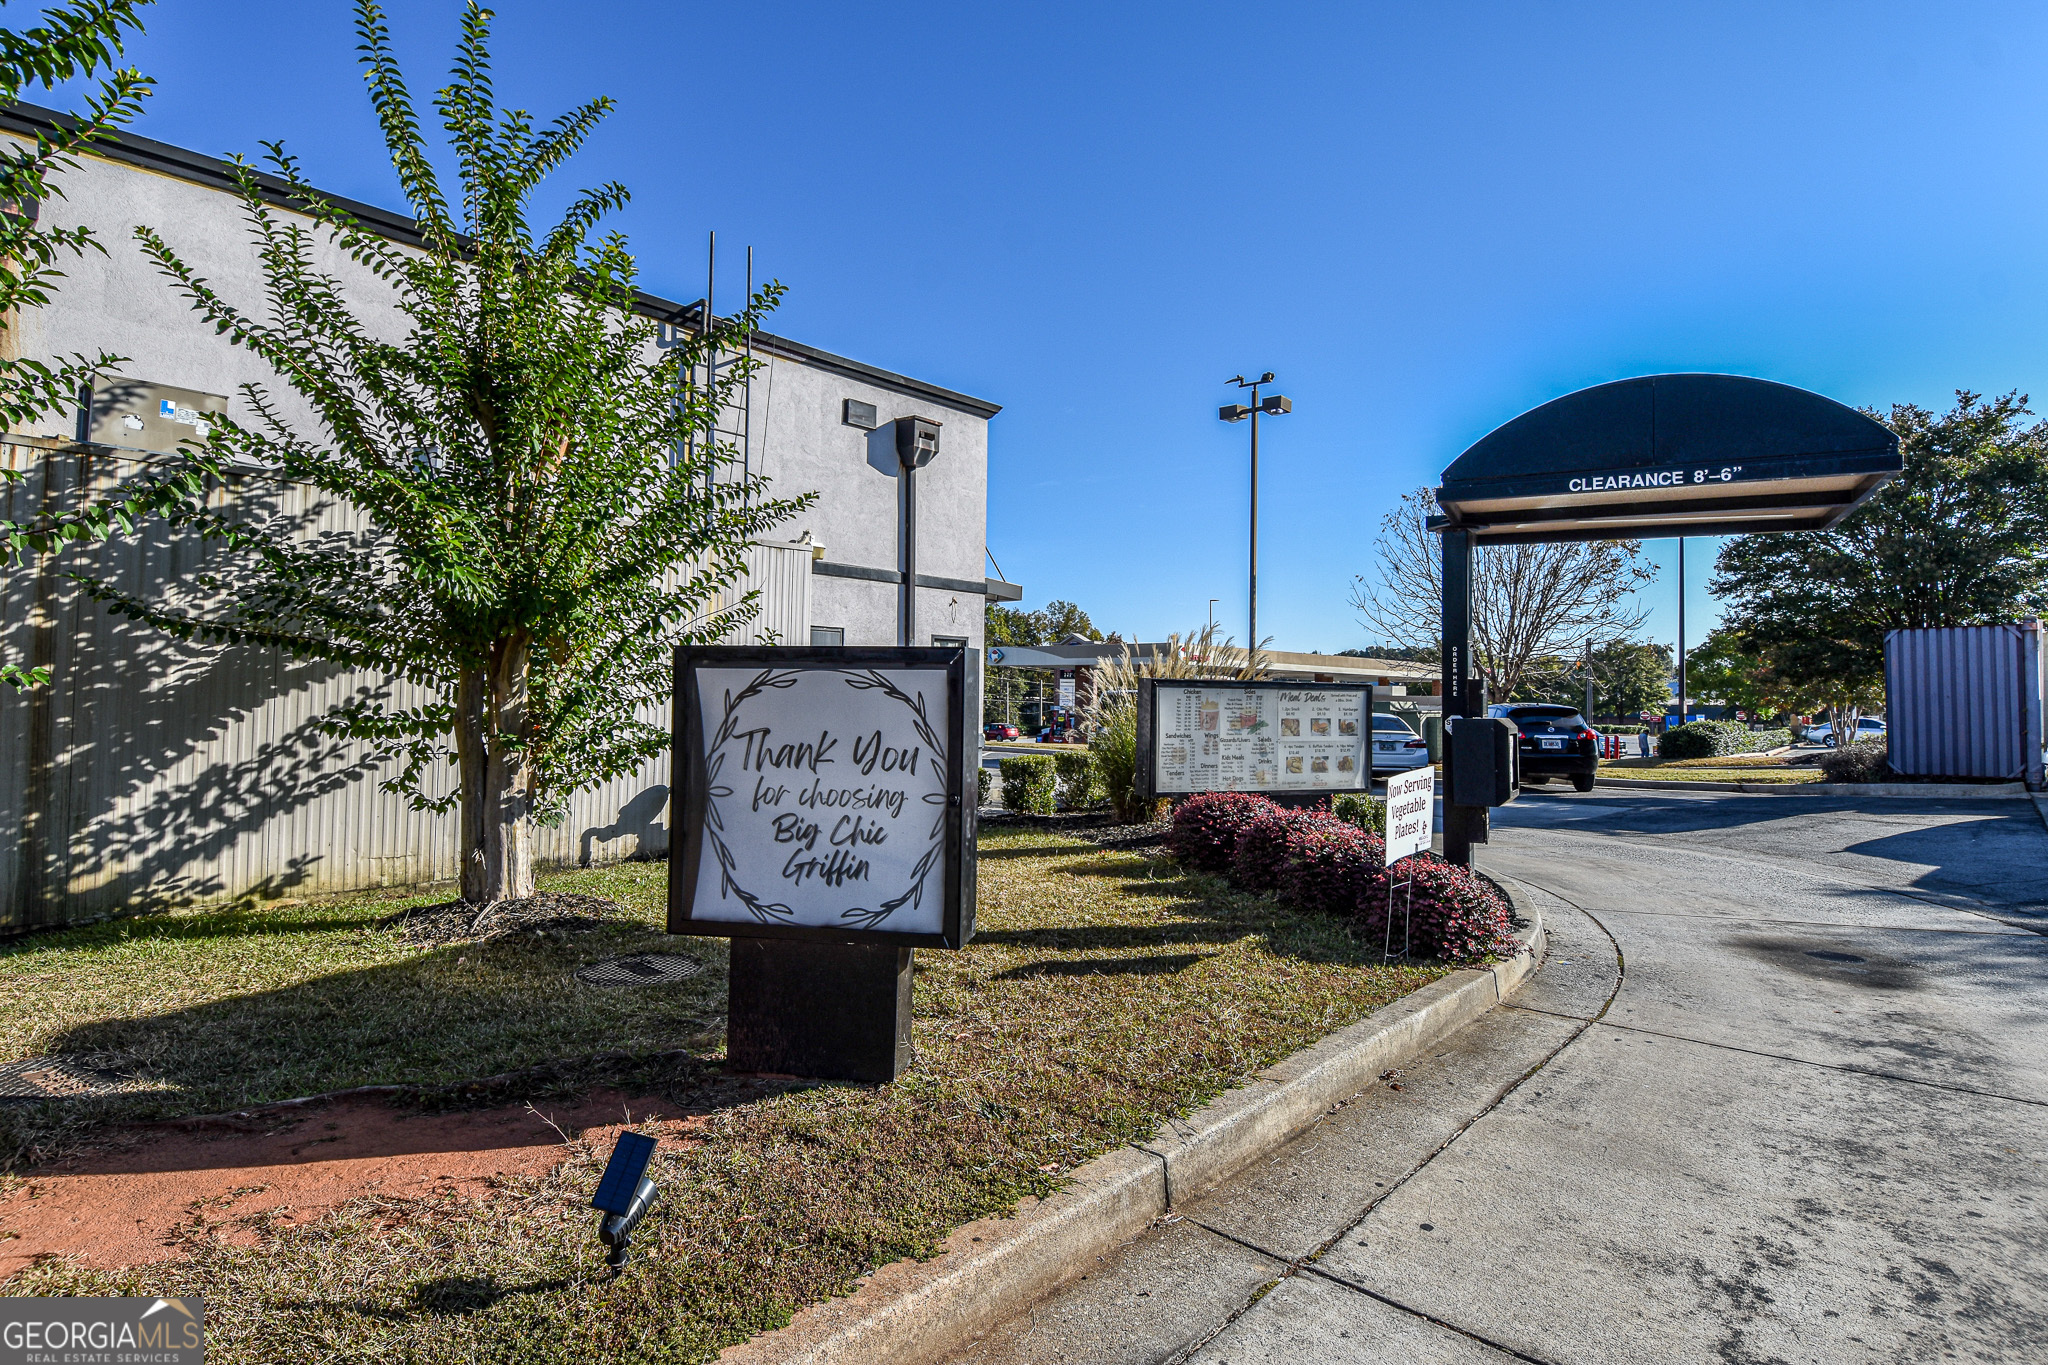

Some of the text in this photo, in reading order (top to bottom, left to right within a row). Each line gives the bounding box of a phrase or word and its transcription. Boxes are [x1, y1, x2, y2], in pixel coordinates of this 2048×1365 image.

[1568, 470, 1684, 492] CLEARANCE
[1280, 691, 1326, 702] Meal Deals
[732, 727, 920, 776] Thank You
[752, 775, 909, 819] for choosing
[1388, 775, 1432, 800] Now Serving
[1391, 796, 1427, 821] Vegetable
[771, 812, 889, 851] Big Chic
[1394, 818, 1420, 840] Plates!
[781, 847, 870, 887] Griffin
